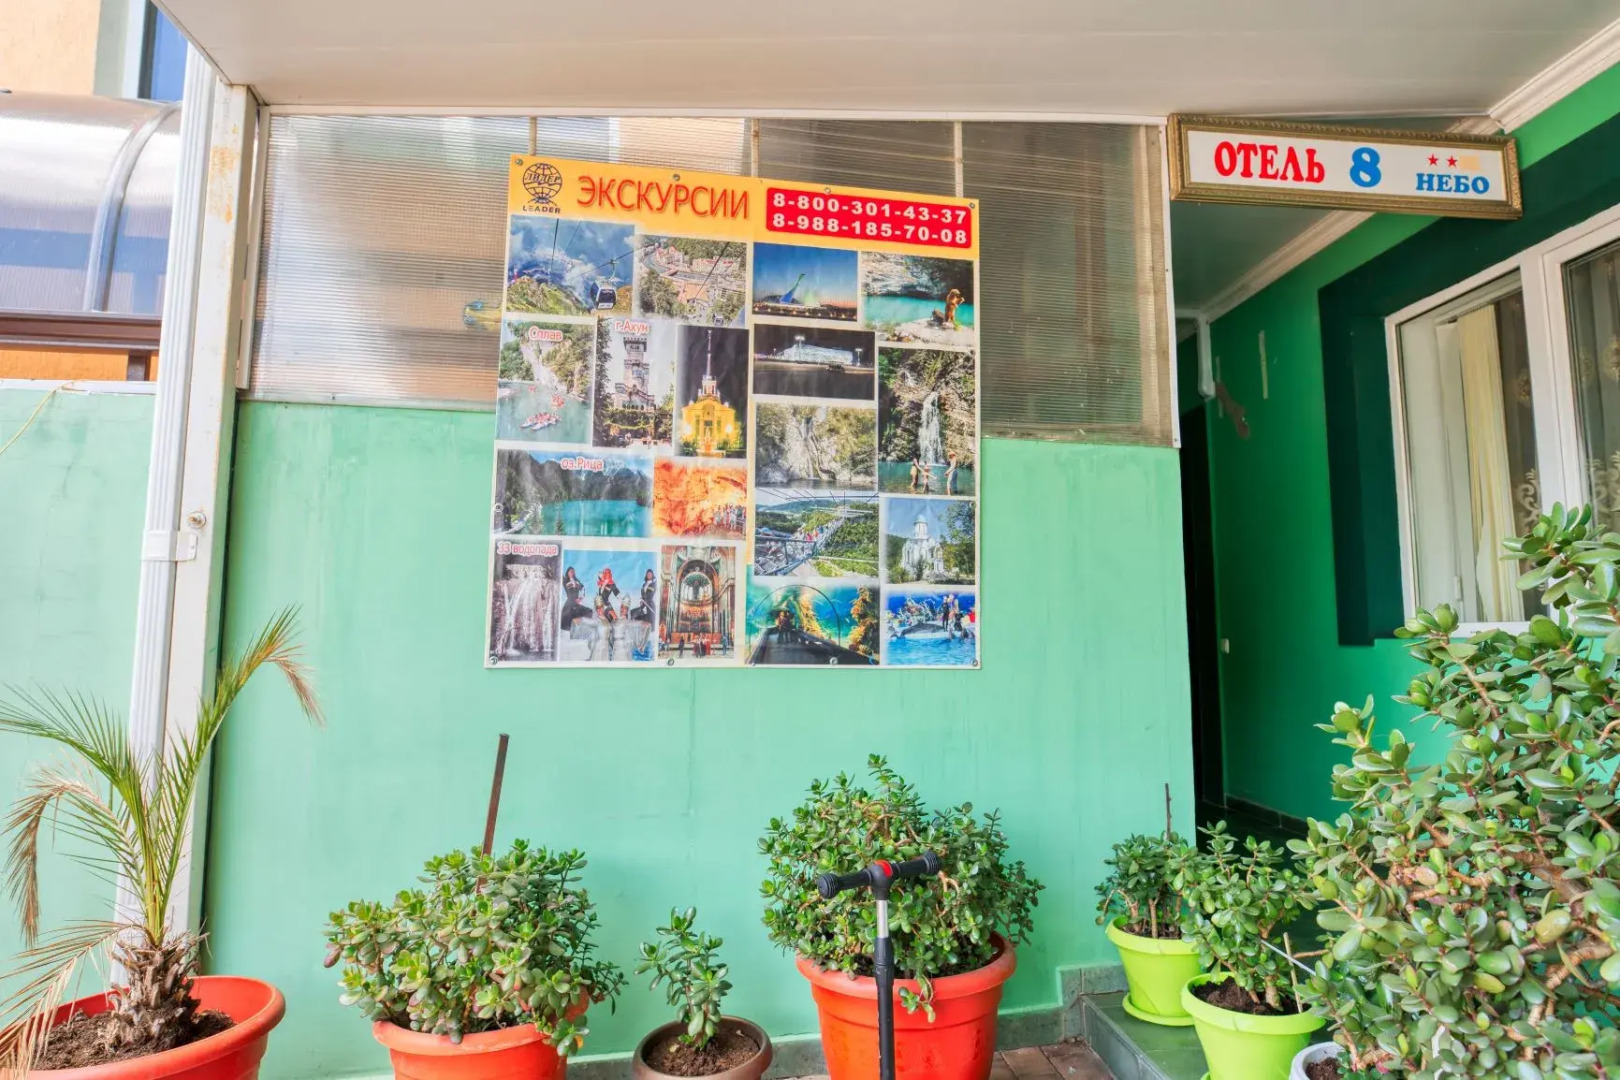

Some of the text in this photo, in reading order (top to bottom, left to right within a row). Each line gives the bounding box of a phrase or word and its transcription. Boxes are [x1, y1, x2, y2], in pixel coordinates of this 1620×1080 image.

[1214, 141, 1490, 195] ОТЕЛЬ 8 НЕБО
[524, 172, 562, 185] ЛИДЕР
[577, 175, 749, 219] ЭКСКУРСИИ
[522, 204, 561, 214] LEADER
[773, 193, 966, 224] 8-800-301-43-37
[773, 213, 967, 244] 8-988-185-70-08
[529, 327, 562, 340] Сплав
[614, 320, 649, 335] г.Ахун
[561, 457, 603, 471] оз.Рица
[497, 541, 557, 556] 33 водопада
